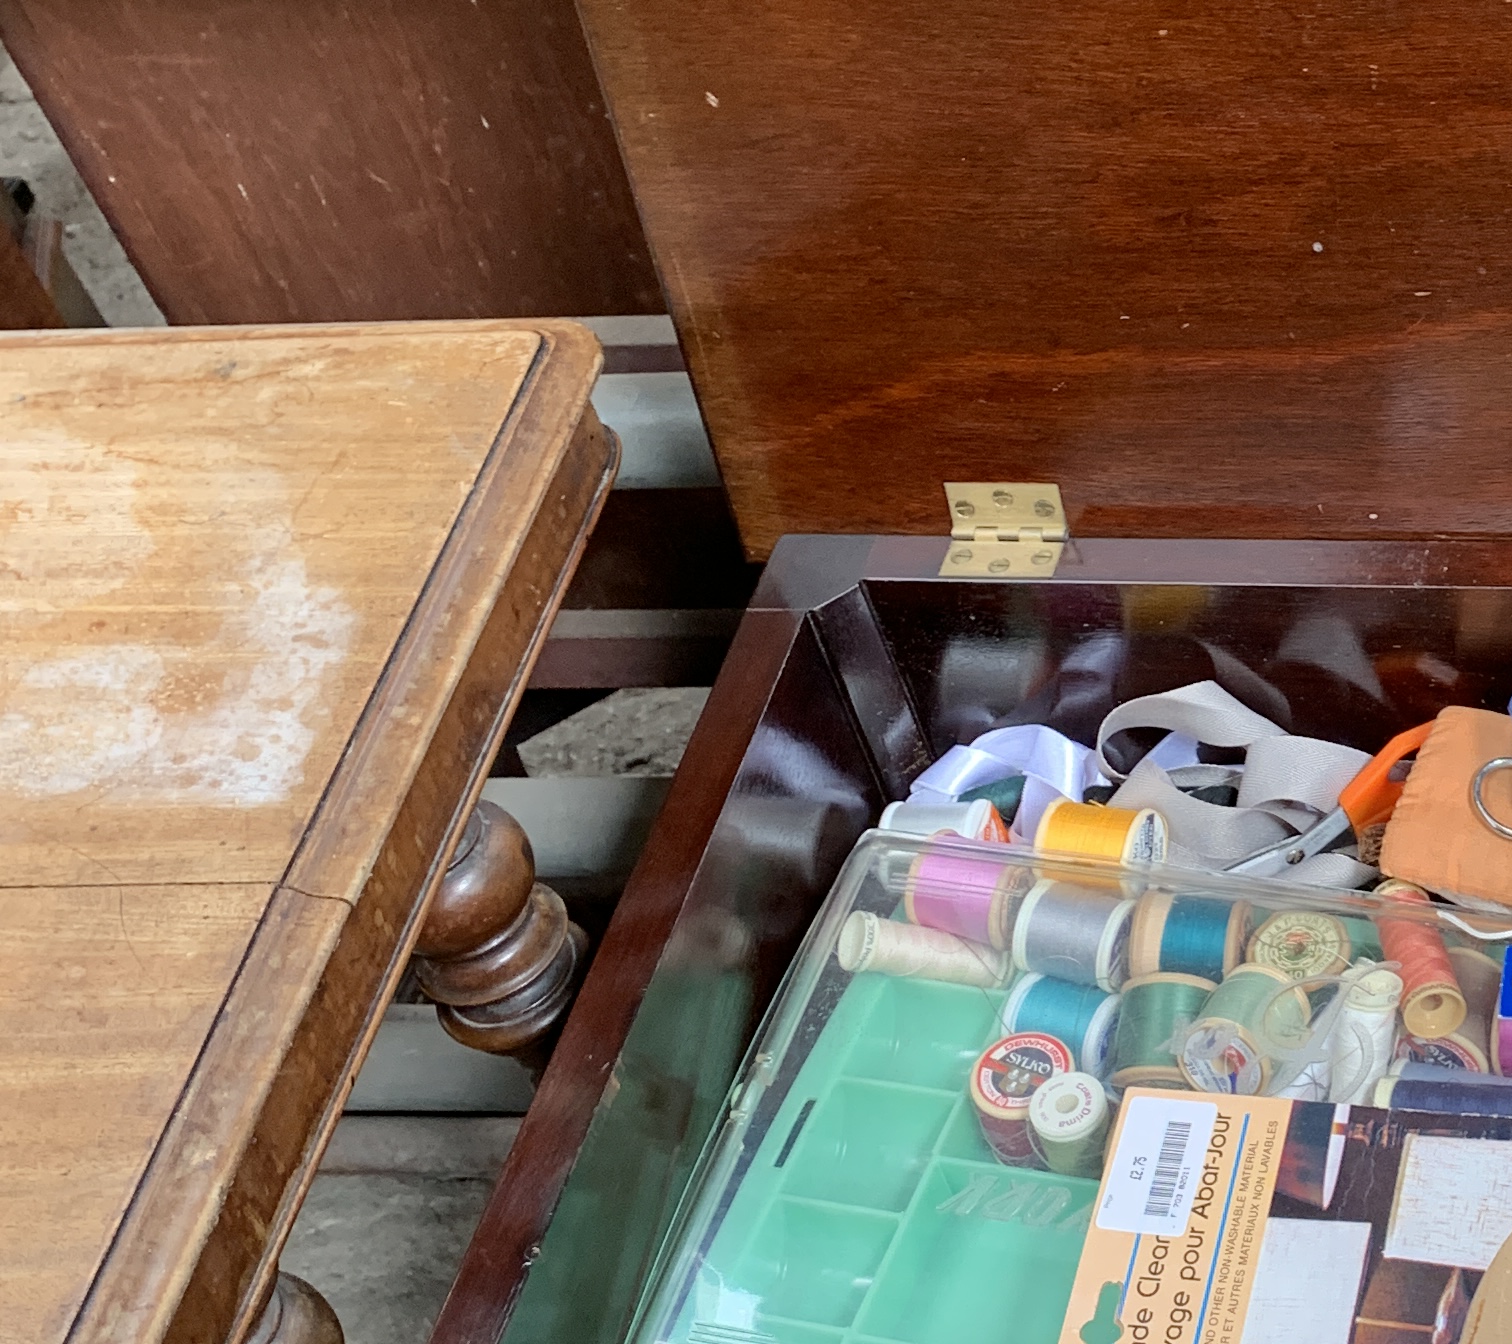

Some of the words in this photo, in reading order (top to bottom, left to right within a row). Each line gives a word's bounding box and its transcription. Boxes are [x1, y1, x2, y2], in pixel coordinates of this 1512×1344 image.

[1006, 1052, 1051, 1075] SYLKO
[1058, 1109, 1092, 1128] Drima
[1130, 1157, 1148, 1181] £2.75
[1191, 1112, 1232, 1219] Abat-Jour
[1208, 1286, 1225, 1327] OTHER
[1218, 1195, 1247, 1284] NON-WASHABLE
[1241, 1140, 1259, 1193] MATERIAL
[1223, 1316, 1235, 1332] ET
[1229, 1269, 1245, 1314] AUTRES
[1241, 1203, 1260, 1266] MATERIAUX
[1254, 1177, 1266, 1201] NON
[1260, 1120, 1279, 1173] LAVABLES
[1180, 1227, 1206, 1282] pour
